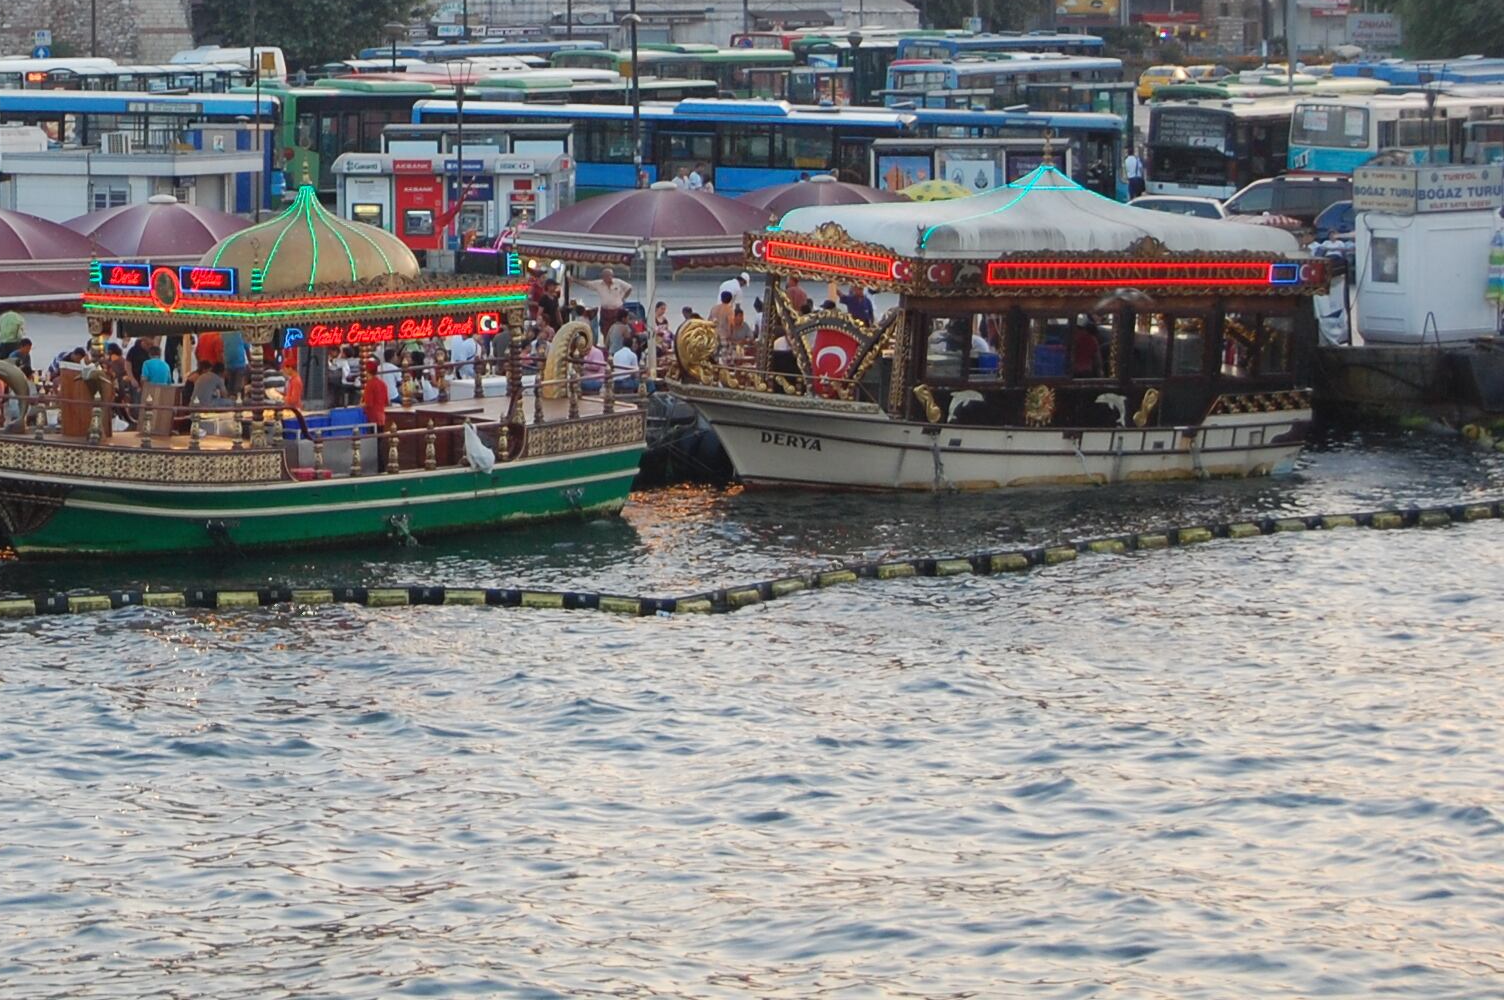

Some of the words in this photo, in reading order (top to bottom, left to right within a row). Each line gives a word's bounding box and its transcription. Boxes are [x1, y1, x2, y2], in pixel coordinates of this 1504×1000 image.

[1442, 173, 1478, 182] TURYOL
[1354, 185, 1386, 197] BOĞAZ
[1390, 188, 1416, 199] TURU
[1418, 184, 1463, 200] BOĞAZ
[1467, 186, 1503, 199] TURU
[308, 325, 343, 347] Tarihi
[346, 321, 395, 344] Eminönü
[398, 316, 434, 340] Balık
[437, 315, 474, 337] Ekmek
[761, 431, 822, 452] DERYA
